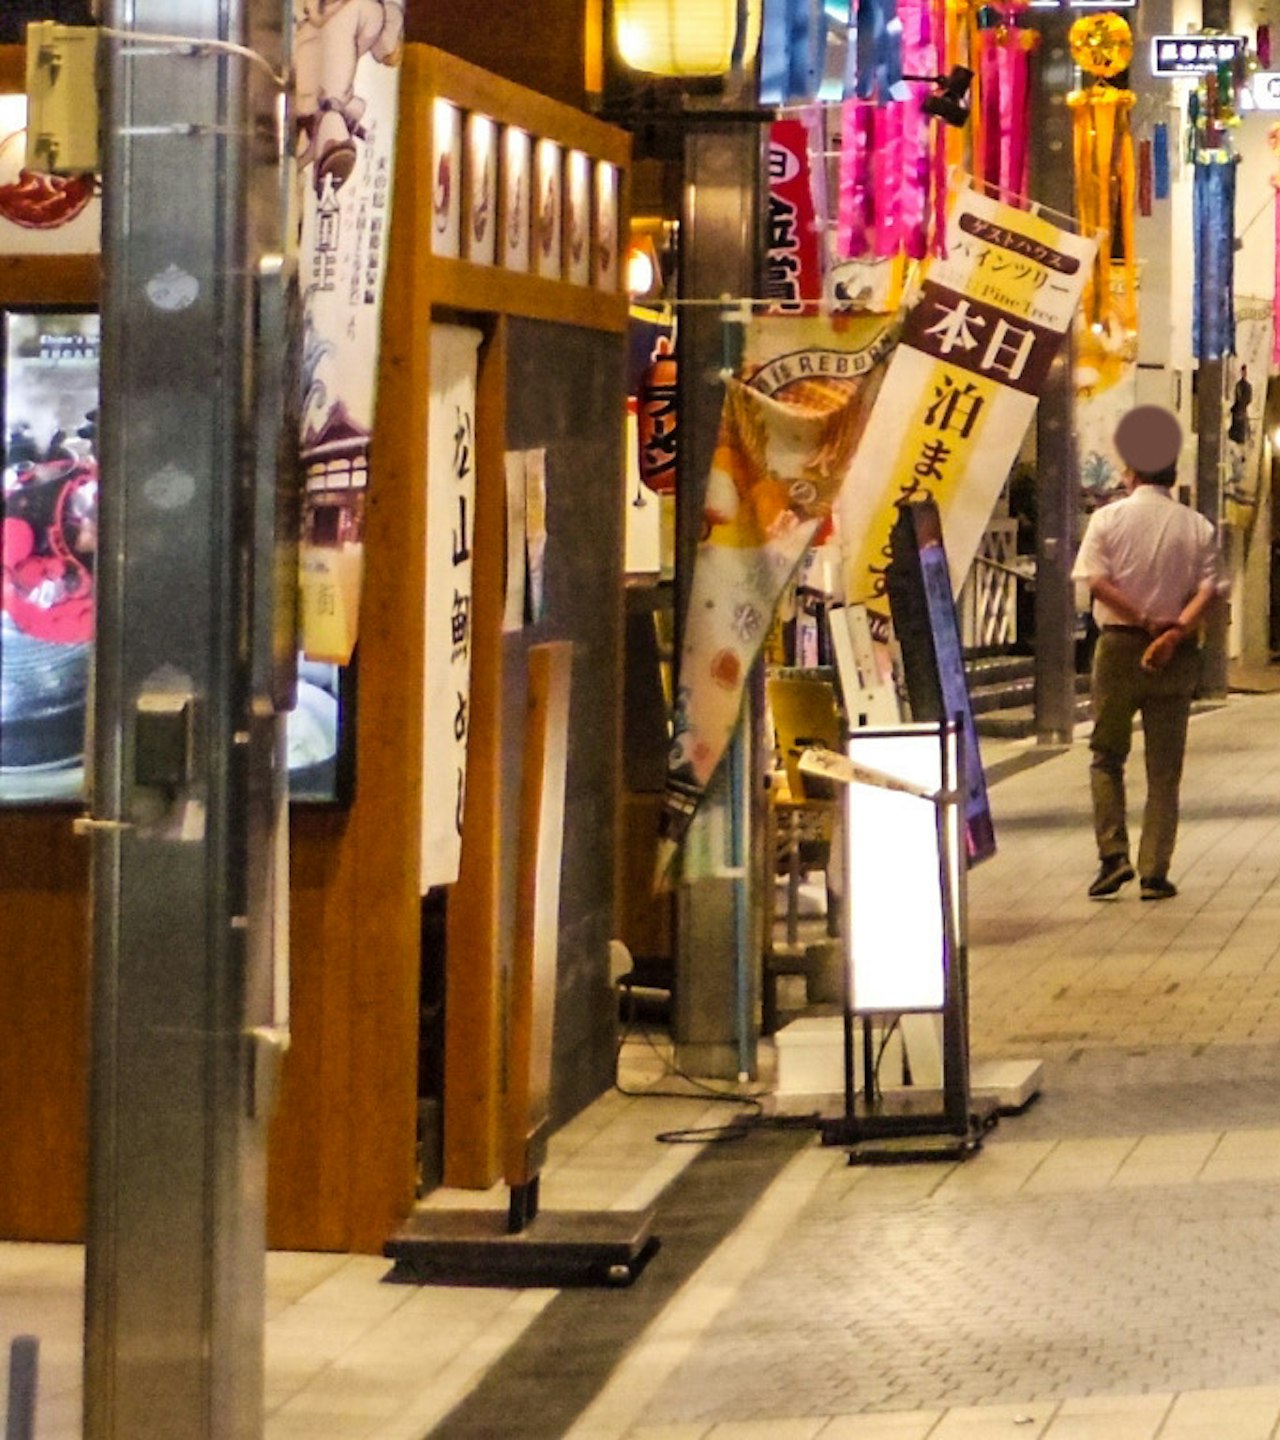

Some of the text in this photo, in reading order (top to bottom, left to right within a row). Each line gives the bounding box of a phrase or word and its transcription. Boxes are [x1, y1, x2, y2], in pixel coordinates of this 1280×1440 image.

[970, 219, 1064, 269] ゲストハウス
[924, 300, 1037, 380] 本日
